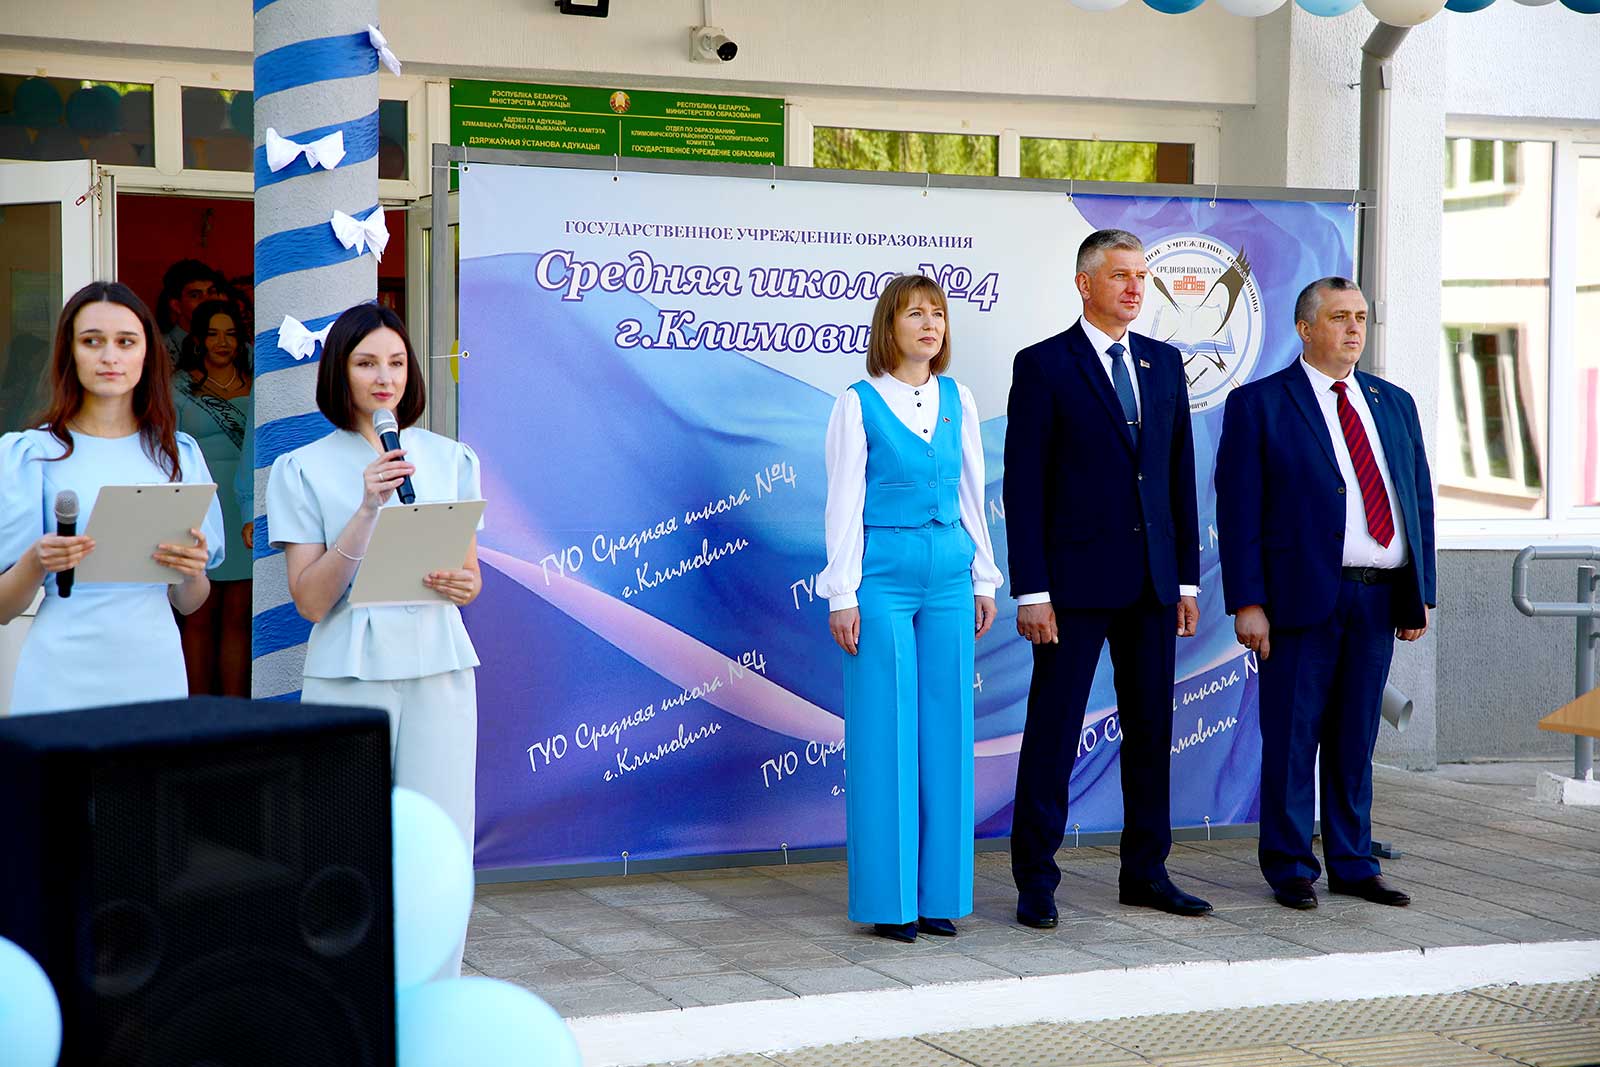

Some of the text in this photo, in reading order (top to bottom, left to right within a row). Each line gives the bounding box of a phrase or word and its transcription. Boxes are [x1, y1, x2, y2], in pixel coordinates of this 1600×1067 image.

[489, 97, 571, 108] МІНІСТЭРСТВА АДУКАЦЫІ
[492, 90, 568, 101] РЭСПУБЛІКА БЕЛАРУСЬ
[676, 101, 750, 112] РЕСПУБЛИКА БЕЛАРУСЬ
[503, 116, 526, 124] АДДЗЕЛ
[536, 118, 566, 126] АДУКАЦЫІ
[665, 108, 761, 119] МИНИСТЕРСТВО ОБРАЗОВАНИЯ
[631, 130, 769, 143] КЛИМОВИЧСКОГО РАЙОННОГО ИСПОЛНИТЕЛЬНОГО
[665, 125, 684, 133] ОТДЕЛ
[694, 127, 736, 135] ОБРАЗОВАНИЮ
[469, 135, 521, 147] ДЗЯРЖАЎНАЯ
[562, 141, 600, 151] АДУКАЦЫІ
[631, 144, 776, 159] ГОСУДАРСТВЕННОЕ УЧРЕЖДЕНИЕ ОБРАЗОВАНИЯ
[565, 220, 973, 249] ГОСУДАРСТВЕННОЕ УЧРЕЖДЕНИЕ ОБРАЗОВАНИЯ
[1167, 240, 1224, 256] УЧРЕЖДЕНИЕ
[535, 248, 741, 302] Средняя
[1156, 266, 1186, 274] СРЕДНЯЯ
[1186, 266, 1210, 274] ШКОЛА
[616, 309, 872, 355] г.Климови
[540, 461, 797, 586] ГУО Средняя школа №4
[622, 537, 749, 599] г.Климовичи
[790, 574, 815, 610] ГУ
[1182, 669, 1240, 705] школа
[526, 649, 767, 772] ГУО Средняя школа №4
[1170, 717, 1238, 757] мовичи
[603, 721, 722, 782] г.Климовичи
[760, 751, 798, 788] ГУО
[805, 739, 846, 768] Сред
